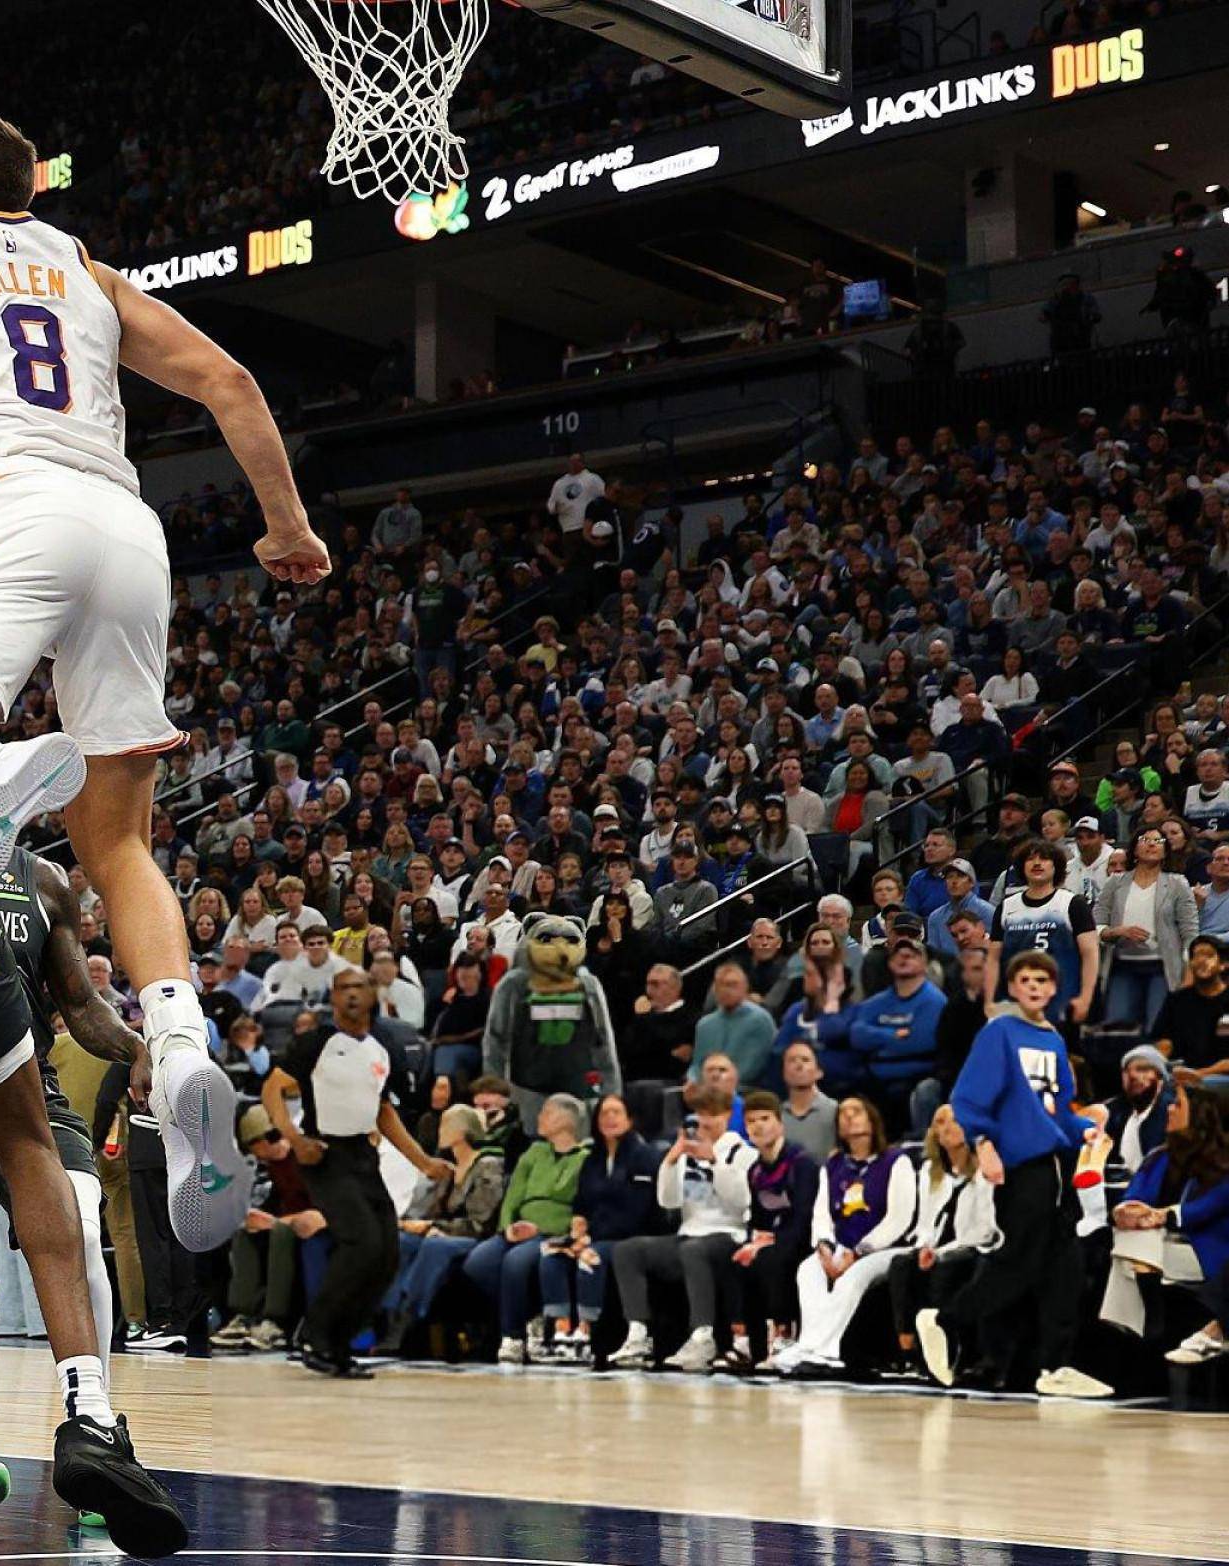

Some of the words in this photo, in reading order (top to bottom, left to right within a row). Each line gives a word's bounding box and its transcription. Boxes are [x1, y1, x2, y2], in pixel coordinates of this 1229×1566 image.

[1052, 28, 1145, 98] DUOS
[35, 153, 72, 193] UOS
[482, 177, 511, 221] 2
[248, 219, 313, 276] DUOS
[1, 303, 74, 414] 8
[542, 411, 580, 436] 110
[1008, 921, 1057, 931] MINNESOTA
[1034, 931, 1050, 950] 5
